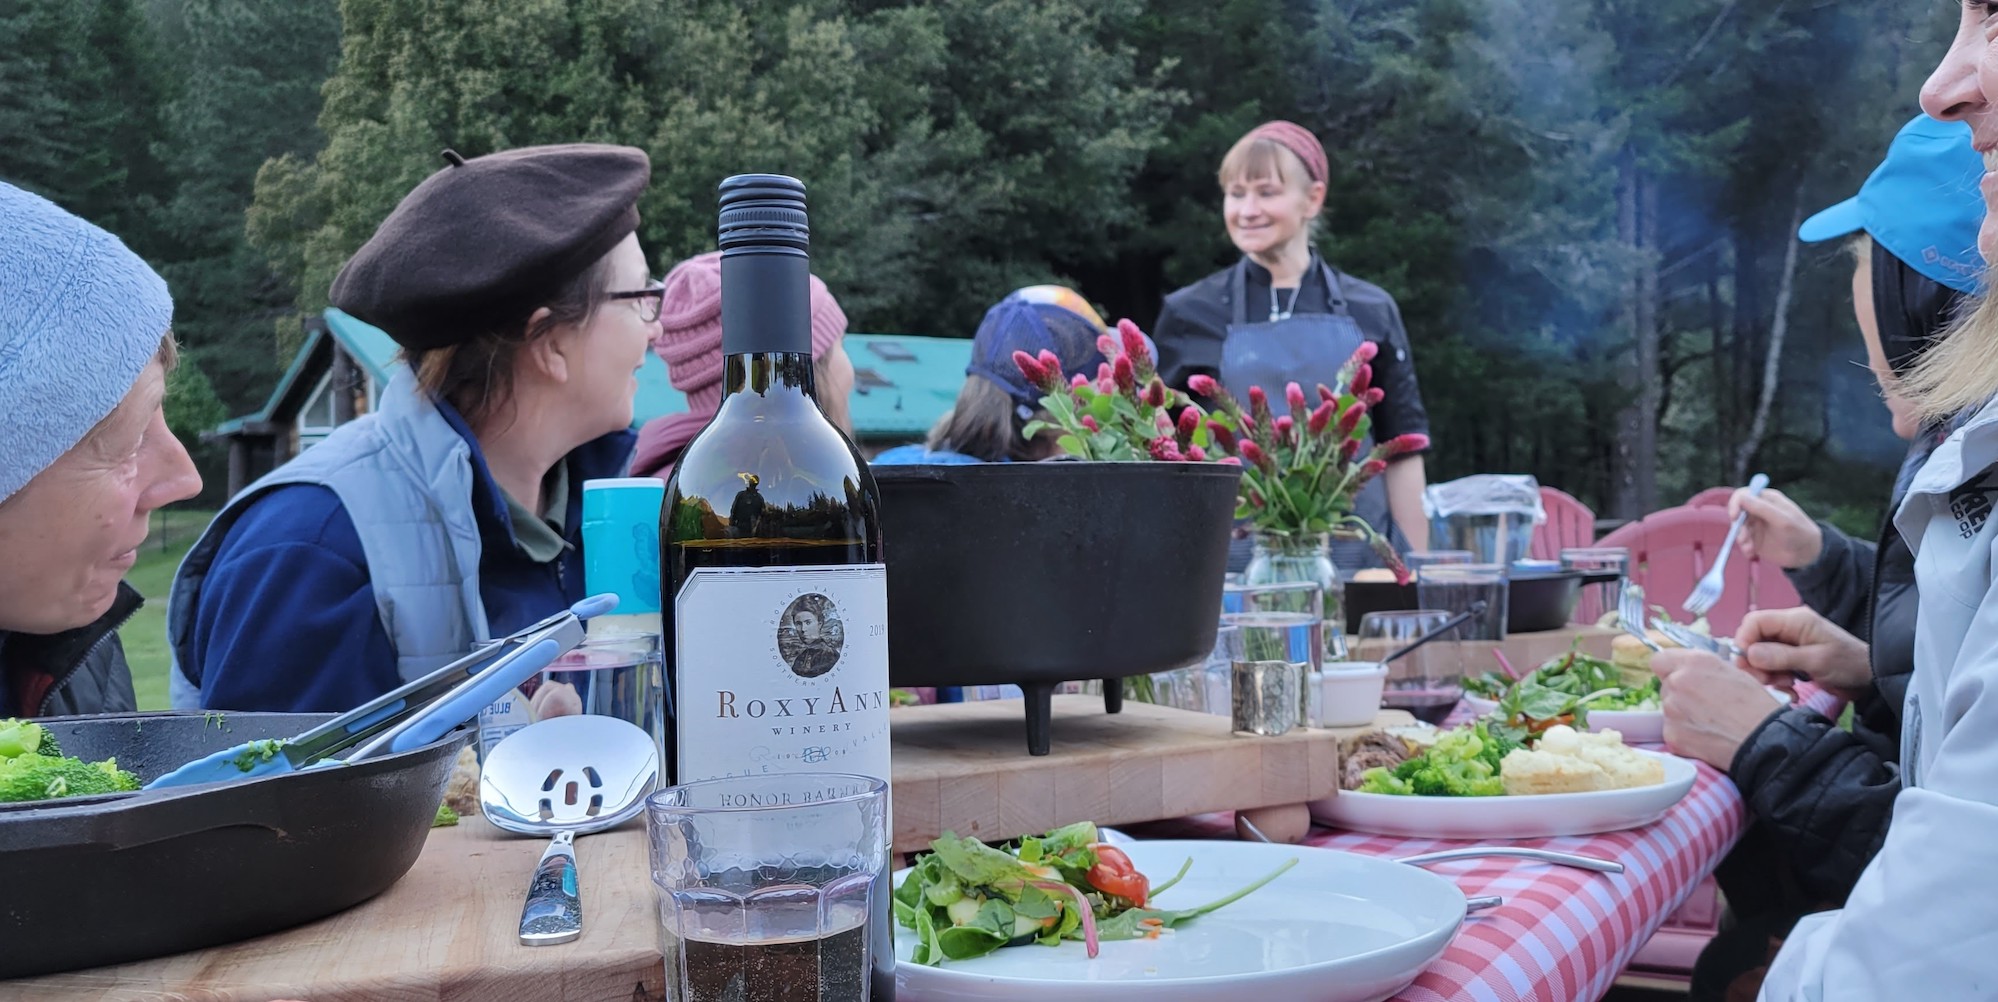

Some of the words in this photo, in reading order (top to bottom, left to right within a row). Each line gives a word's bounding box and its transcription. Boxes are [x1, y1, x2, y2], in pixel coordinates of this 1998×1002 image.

[770, 587, 802, 625] ROGUE
[814, 585, 850, 622] VALLEY
[770, 648, 816, 687] SOUTHERN
[824, 644, 850, 683] OREGON
[772, 722, 852, 736] WINERY
[719, 792, 793, 807] HONOR
